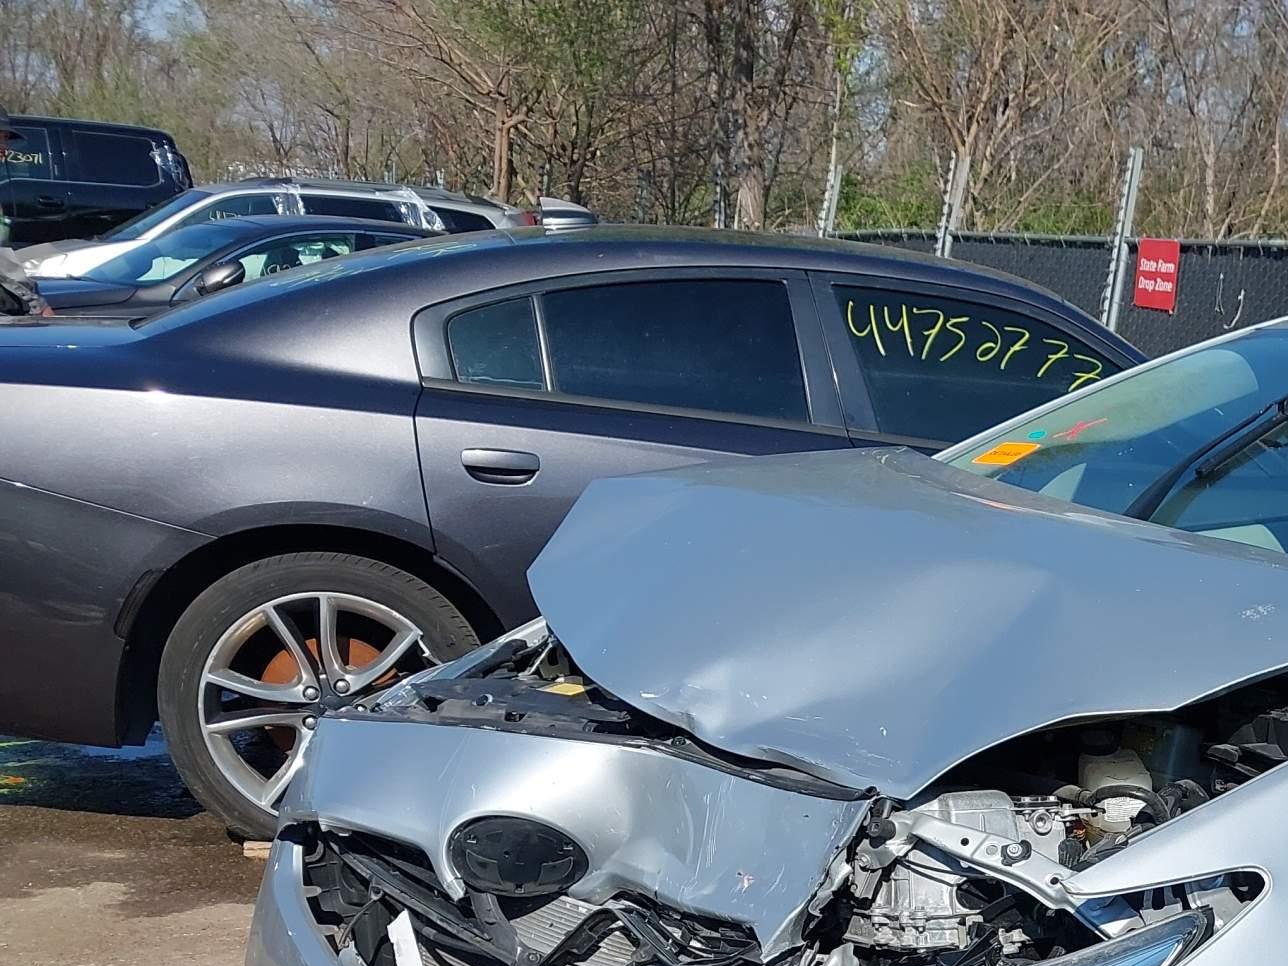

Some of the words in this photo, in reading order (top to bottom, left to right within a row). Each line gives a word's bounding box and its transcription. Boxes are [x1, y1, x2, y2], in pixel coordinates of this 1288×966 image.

[1140, 257, 1157, 272] State
[1157, 258, 1175, 273] Farm
[1138, 275, 1155, 292] Drop
[1155, 277, 1173, 292] Zone
[847, 300, 1103, 392] 44752777
